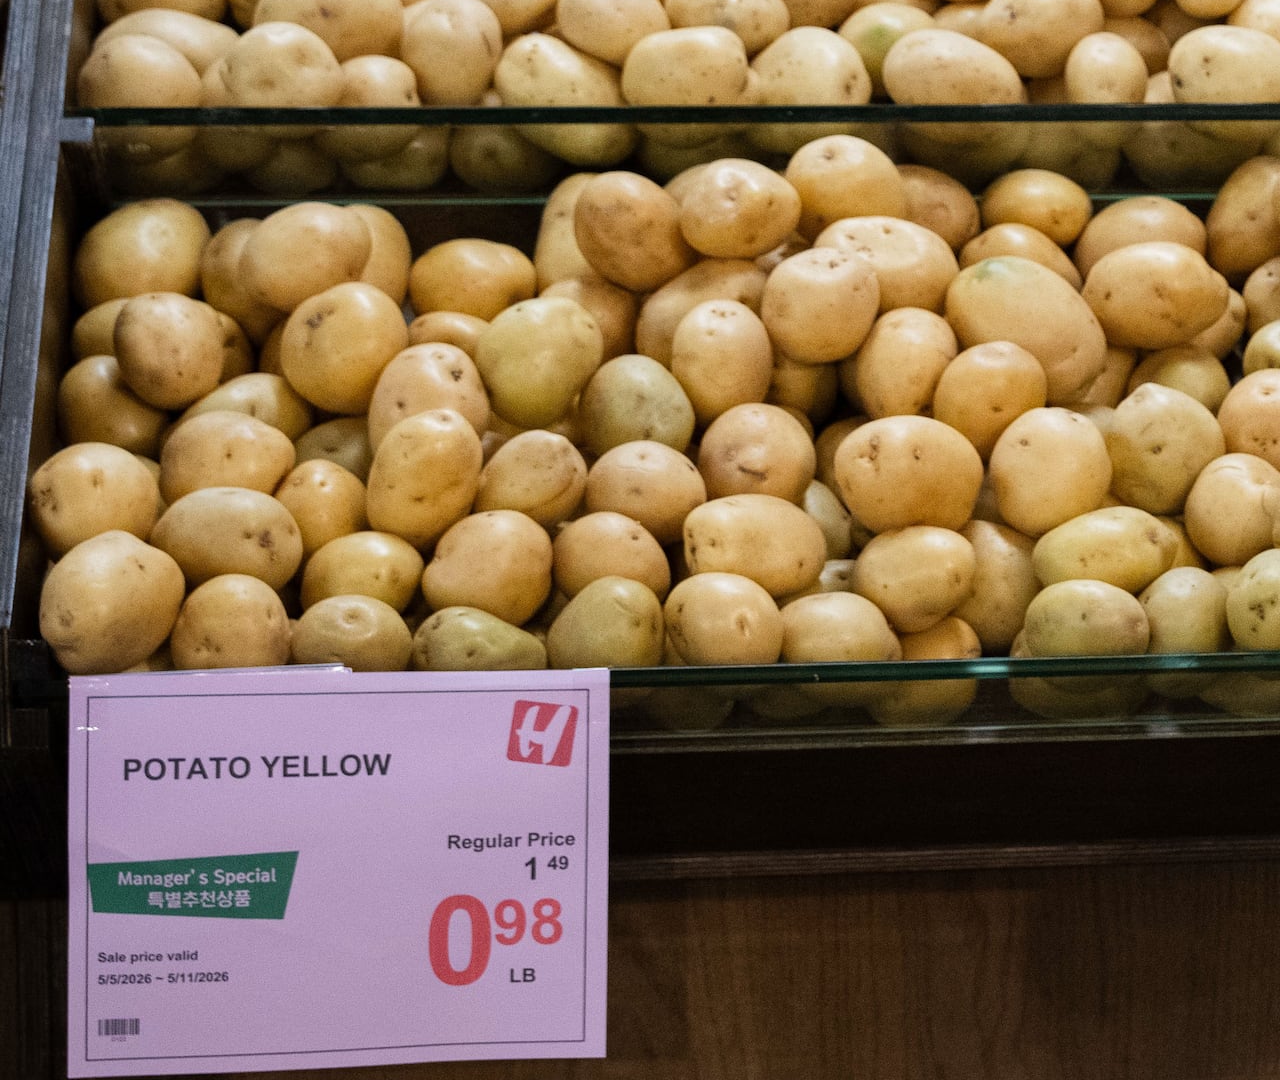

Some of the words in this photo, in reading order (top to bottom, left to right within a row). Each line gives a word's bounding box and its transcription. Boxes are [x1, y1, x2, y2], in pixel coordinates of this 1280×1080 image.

[123, 756, 251, 782] POTATO
[261, 753, 392, 779] YELLOW
[447, 832, 522, 852] Regular
[527, 831, 576, 847] Price
[213, 867, 277, 886] Special
[524, 856, 539, 881] 1
[546, 855, 570, 872] 49
[147, 889, 251, 909] 특별추천상품
[428, 894, 492, 986] 0
[493, 897, 563, 946] 98
[98, 951, 126, 963] Sale
[130, 951, 163, 966] price
[166, 950, 198, 962] valid
[97, 973, 152, 986] 5/5/2026
[167, 971, 230, 984] 5/11/2026
[509, 967, 536, 984] LB
